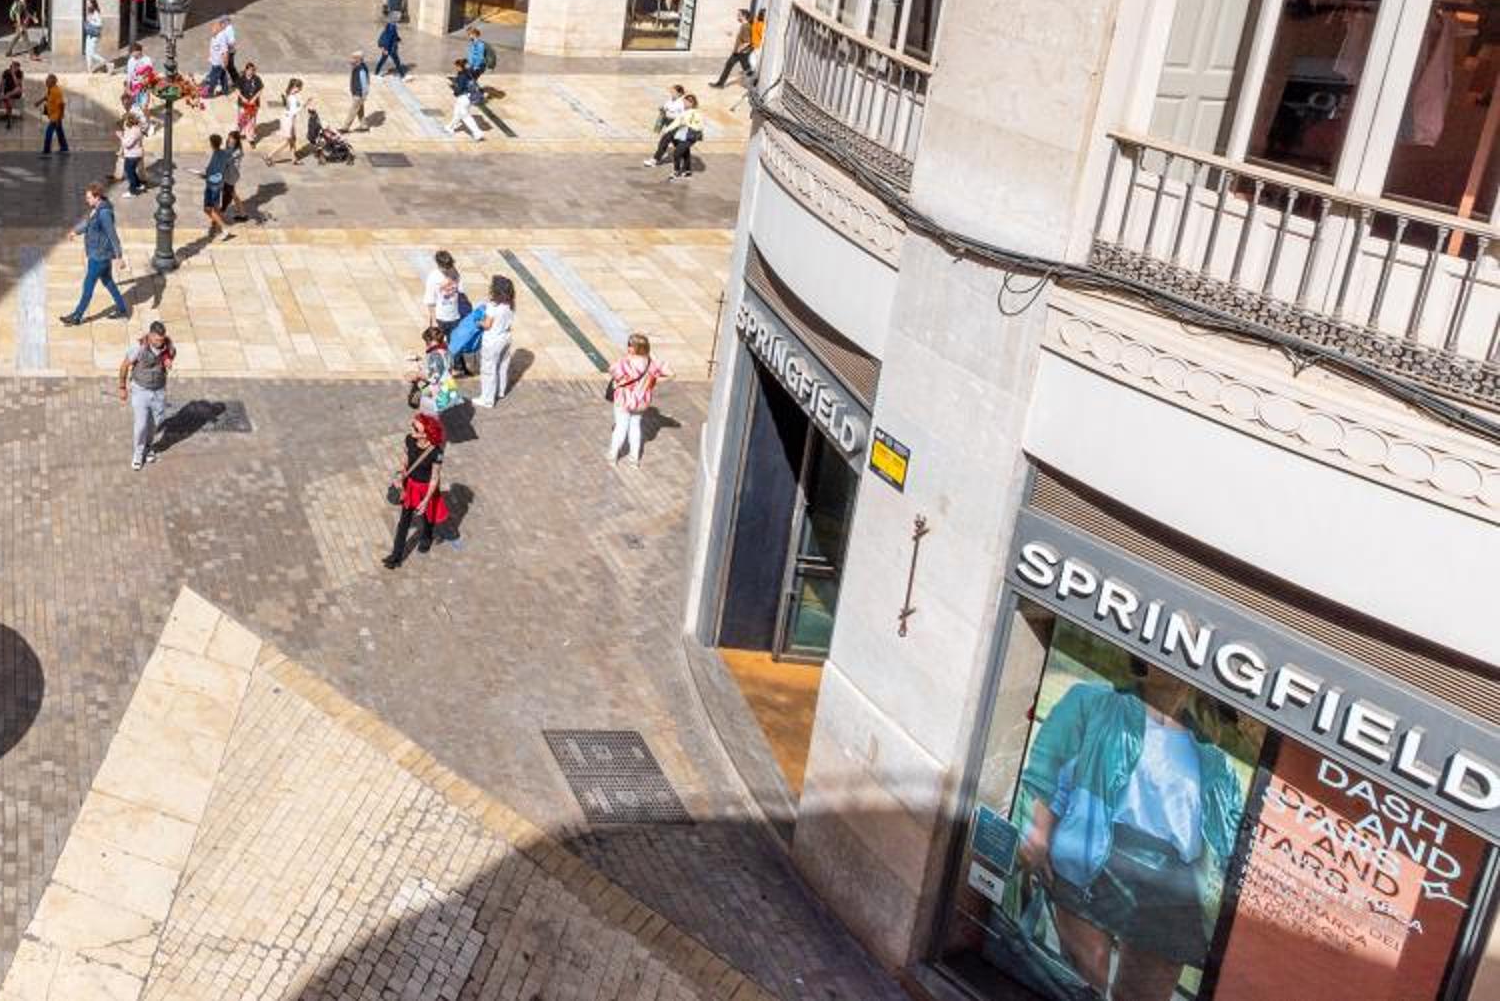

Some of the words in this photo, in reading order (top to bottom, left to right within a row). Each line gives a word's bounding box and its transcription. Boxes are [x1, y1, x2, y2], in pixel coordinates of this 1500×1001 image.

[736, 303, 858, 453] SPRINGFIELD
[1016, 540, 1500, 812] SPRINGFIELD
[1317, 758, 1448, 845] DASH
[1356, 813, 1462, 880] AND
